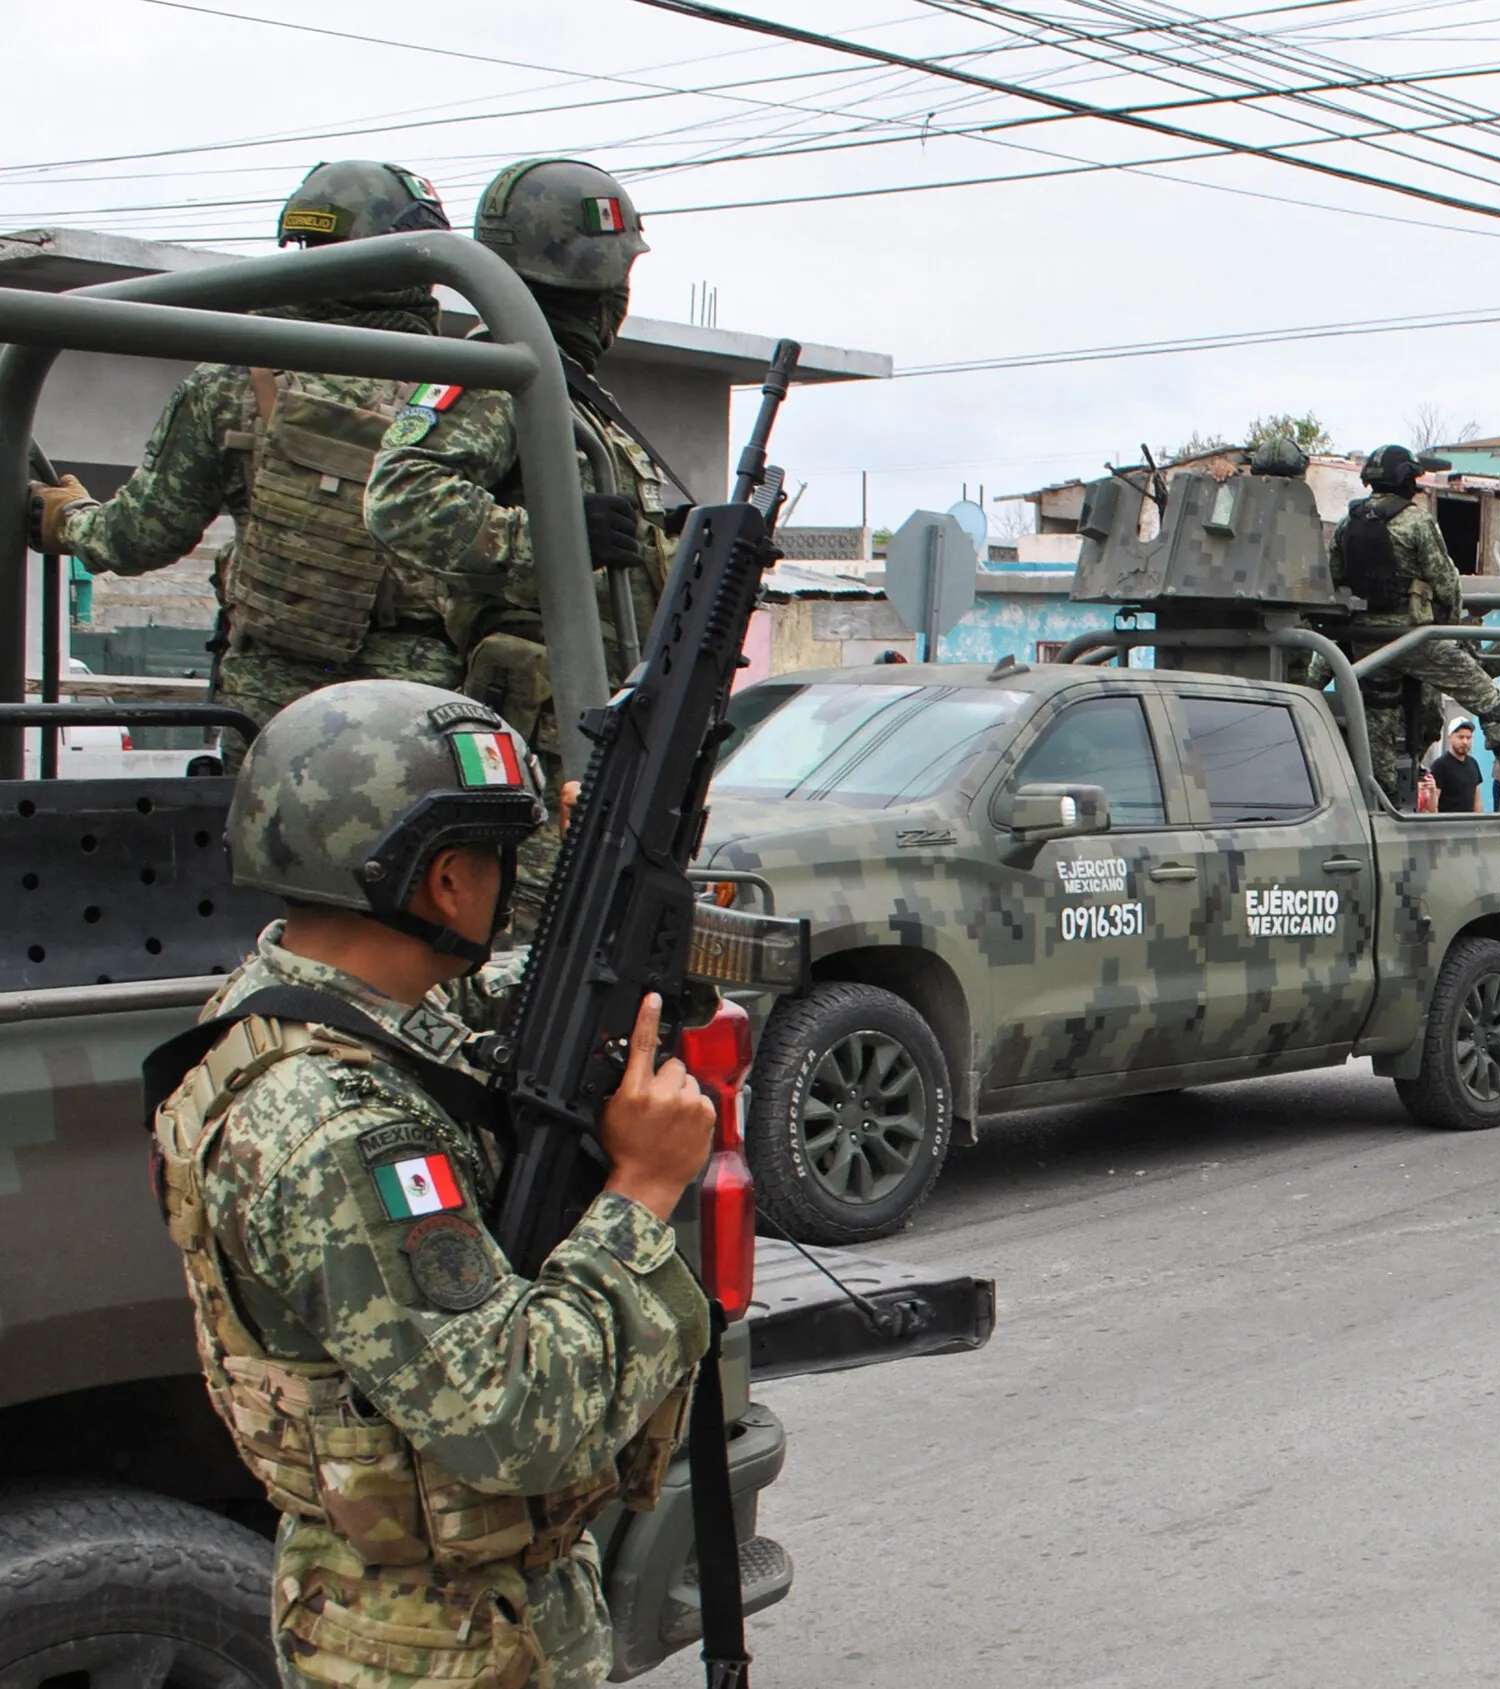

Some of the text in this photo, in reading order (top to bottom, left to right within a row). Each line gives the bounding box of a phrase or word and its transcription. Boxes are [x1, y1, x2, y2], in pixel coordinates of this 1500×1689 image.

[1056, 855, 1128, 879] EJÉRCITO
[1064, 878, 1124, 894] MEXICANO
[1246, 884, 1339, 915] EJÉRCITO
[1062, 902, 1143, 941] 0916351
[1247, 915, 1336, 936] MEXICANO
[789, 1048, 817, 1179] ROADCRUZA
